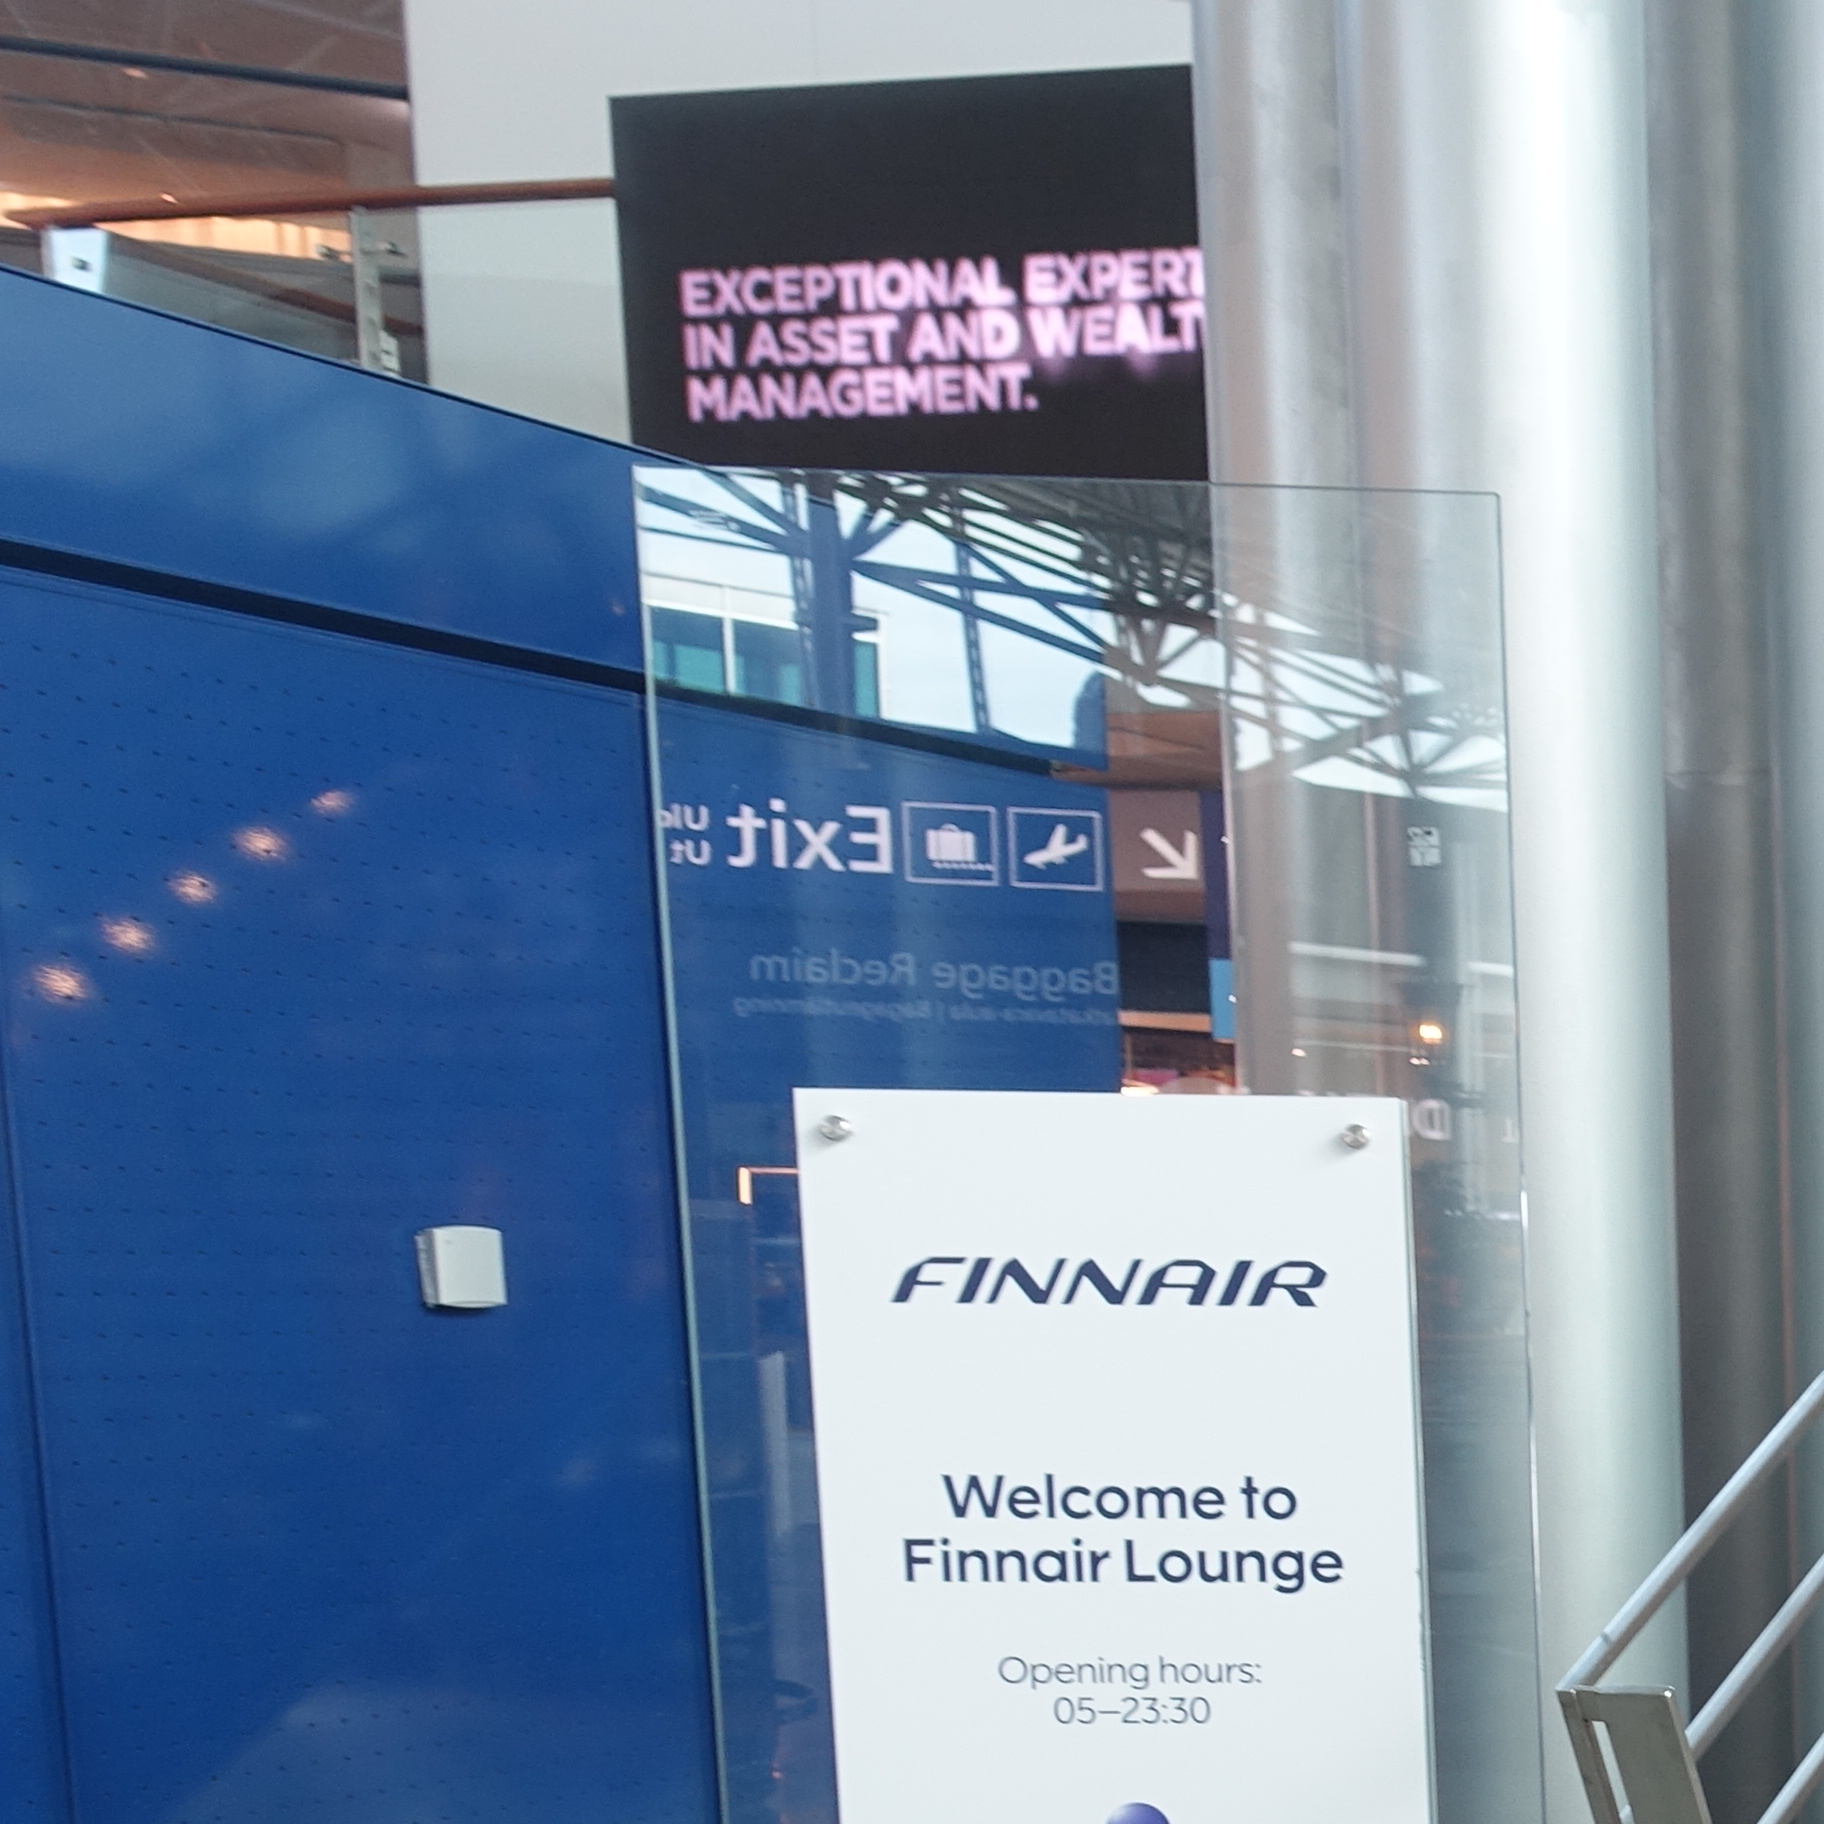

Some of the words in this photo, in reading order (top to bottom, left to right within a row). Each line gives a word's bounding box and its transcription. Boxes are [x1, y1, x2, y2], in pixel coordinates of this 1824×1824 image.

[681, 256, 1016, 316] EXCEPTIONAL
[685, 322, 734, 369] IN
[746, 315, 898, 367] ASSET
[908, 309, 1019, 362] AND
[686, 361, 1038, 424] MANAGEMENT.
[890, 1255, 1328, 1308] FINNAIR
[943, 1473, 1226, 1520] Welcome
[1241, 1477, 1299, 1520] to
[903, 1537, 1111, 1583] Finnair
[1126, 1539, 1344, 1594] Lounge
[998, 1656, 1149, 1690] Opening
[1158, 1655, 1262, 1686] hours:
